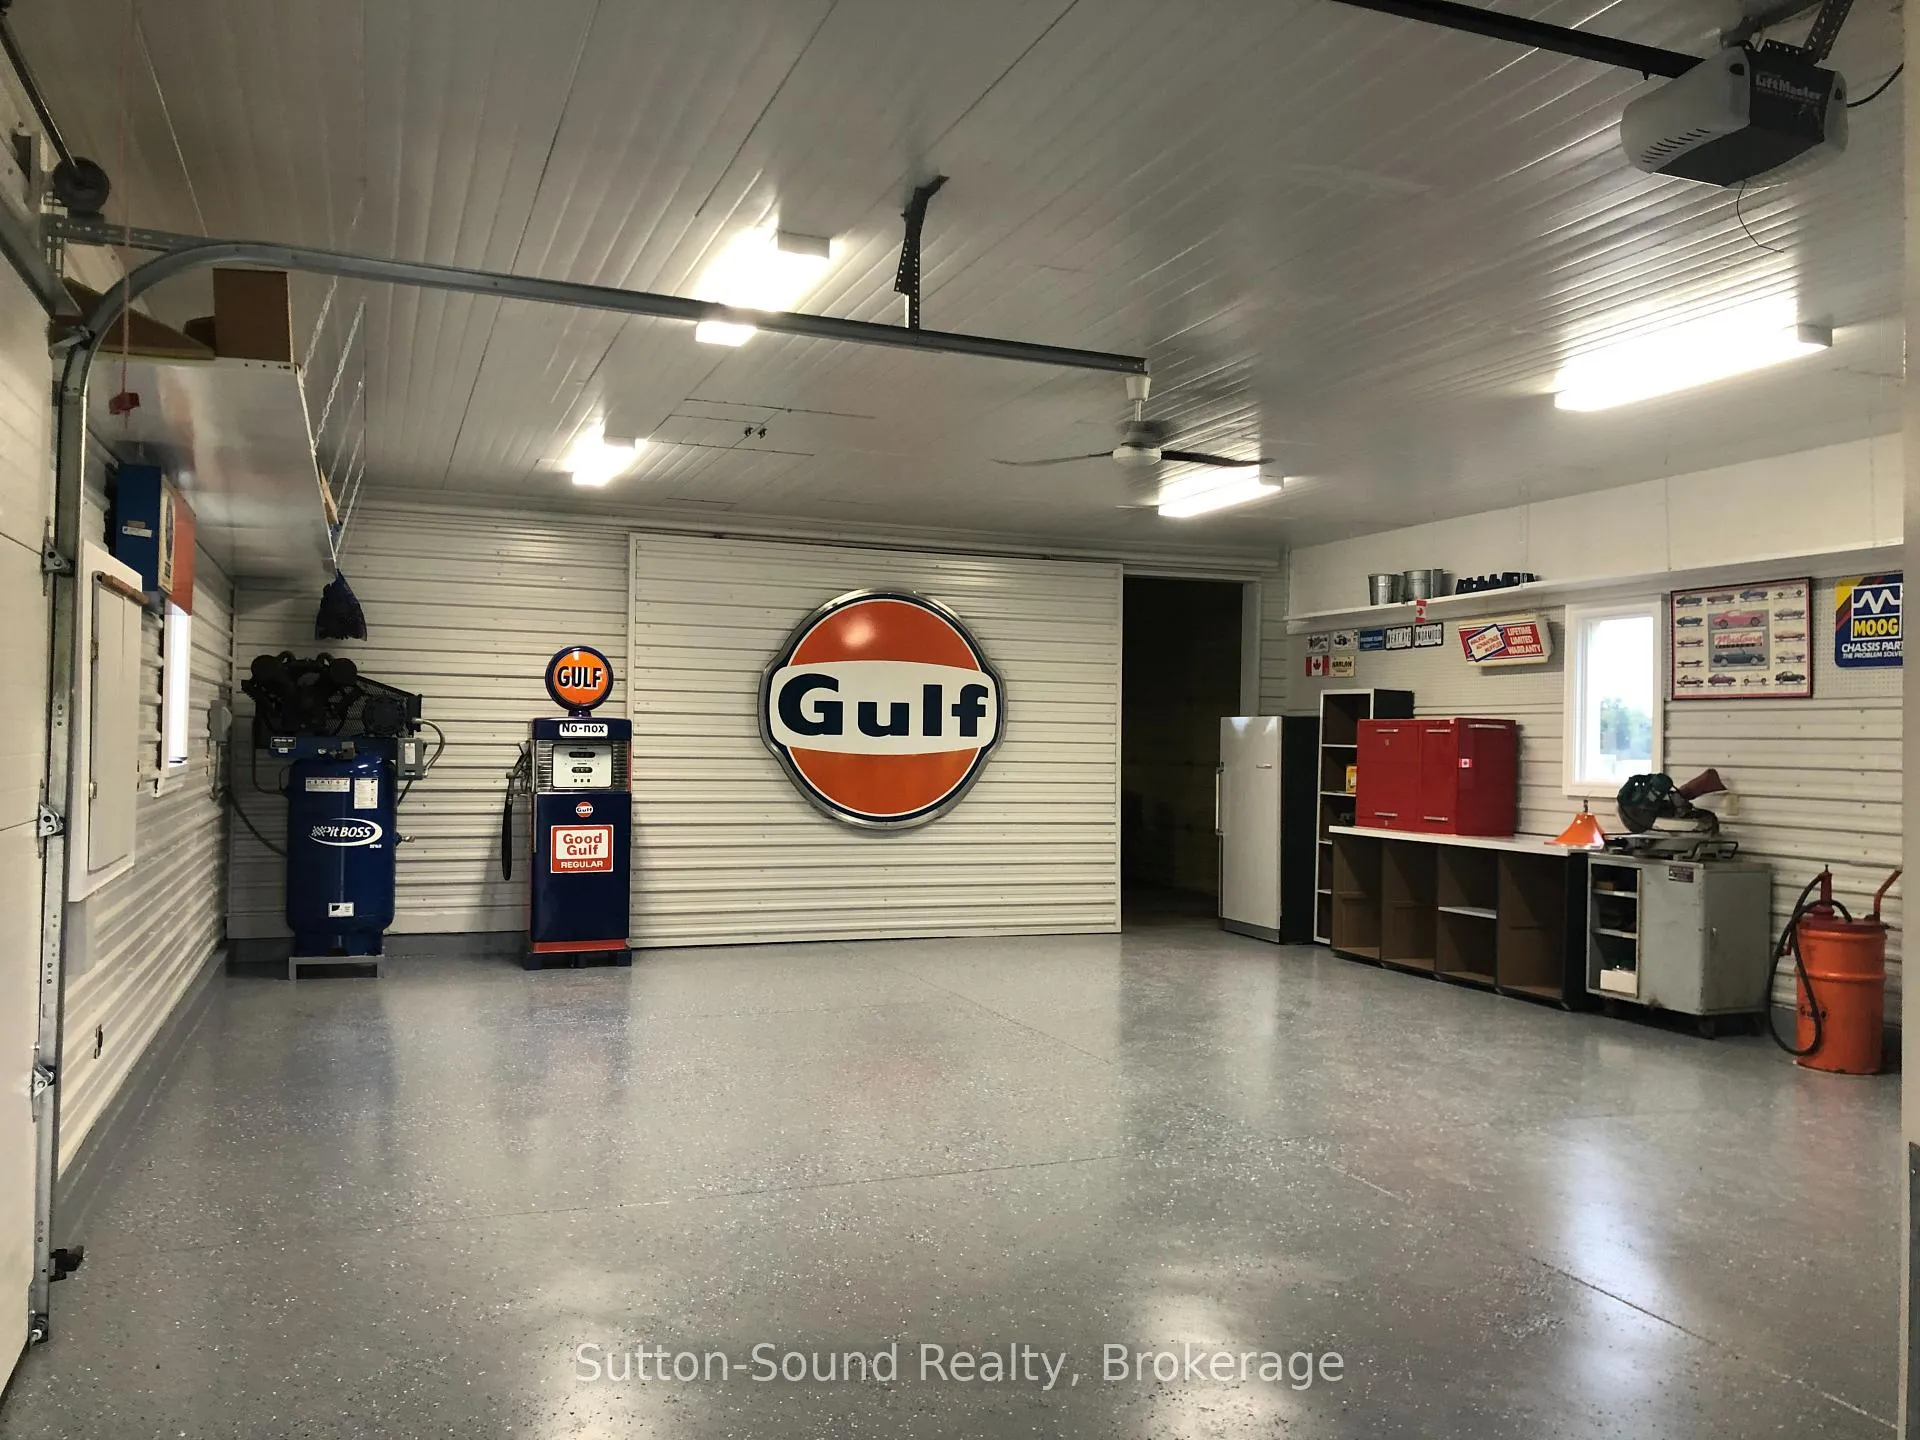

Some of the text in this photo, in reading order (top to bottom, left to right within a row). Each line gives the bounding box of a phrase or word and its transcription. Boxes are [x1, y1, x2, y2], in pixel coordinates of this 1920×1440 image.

[1507, 626, 1532, 636] LIFETIME
[1853, 617, 1899, 637] MOOG
[1511, 635, 1534, 645] LIMITED
[1508, 644, 1541, 655] WARRANTY
[1841, 643, 1881, 653] CHASSIS
[557, 665, 603, 689] GULF
[778, 672, 989, 738] Gulf
[562, 722, 605, 733] No-nox
[340, 826, 371, 838] BOSS
[563, 832, 603, 845] Good
[566, 844, 599, 856] Gulf
[560, 860, 604, 869] REGULAR
